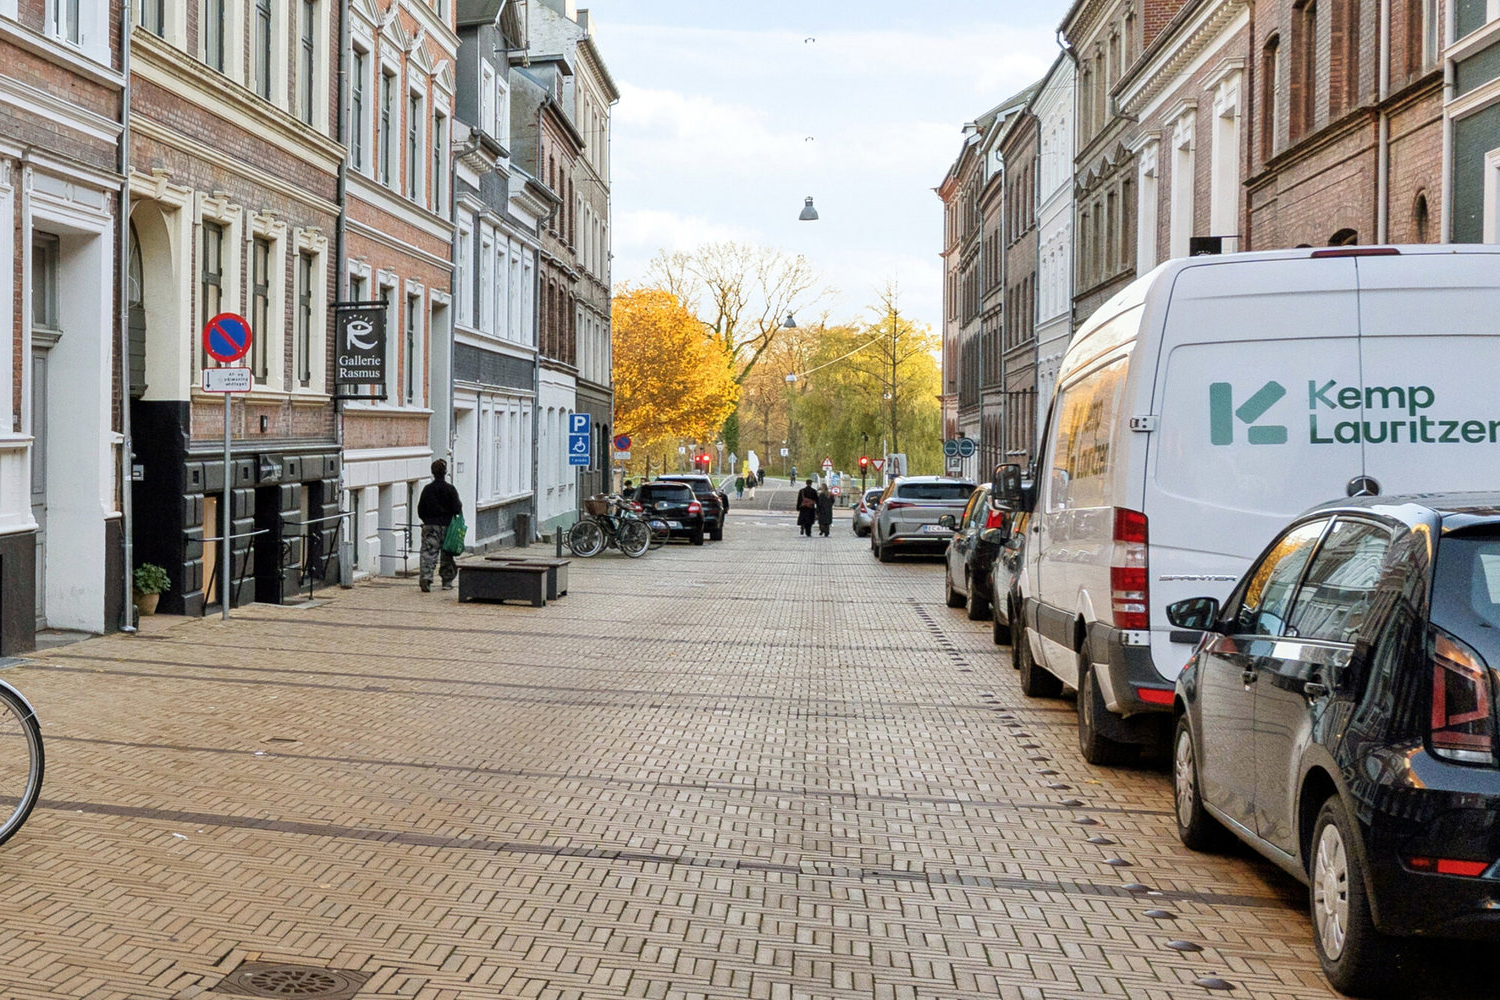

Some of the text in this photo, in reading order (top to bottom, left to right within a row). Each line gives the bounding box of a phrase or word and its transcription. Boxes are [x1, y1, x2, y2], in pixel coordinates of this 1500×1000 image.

[339, 355, 381, 366] Gallerie
[339, 367, 381, 378] Rasmus
[1308, 379, 1435, 417] Kemp
[574, 415, 587, 432] P
